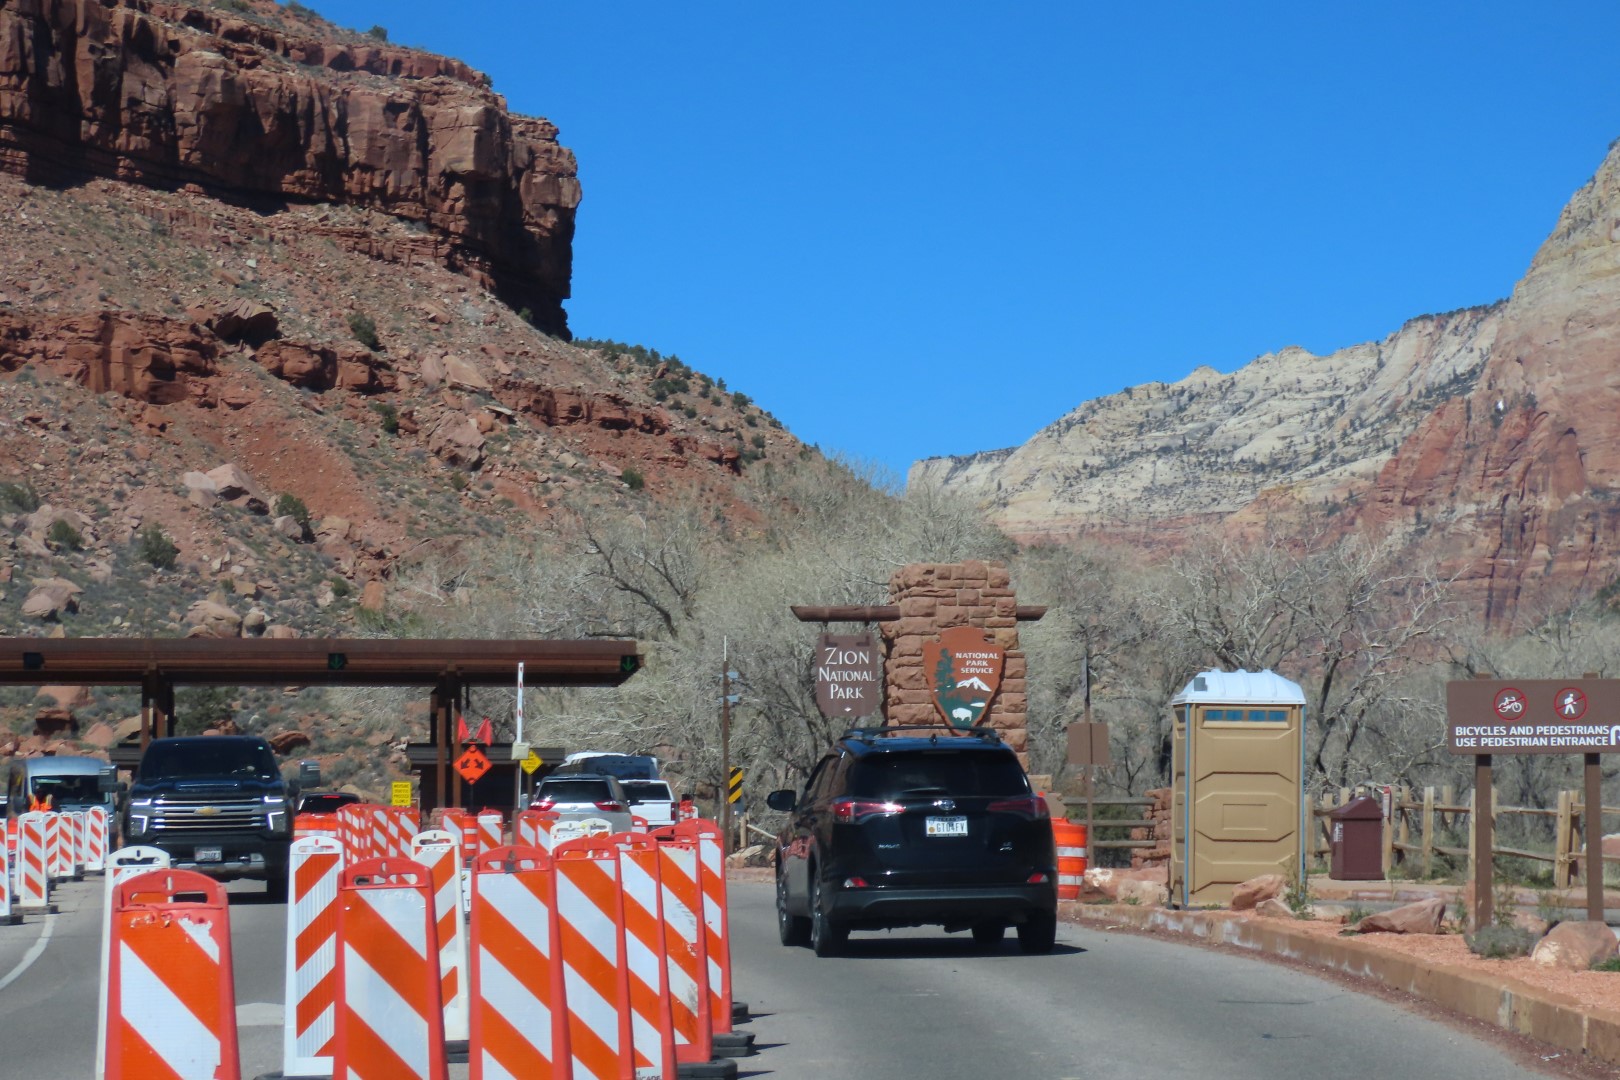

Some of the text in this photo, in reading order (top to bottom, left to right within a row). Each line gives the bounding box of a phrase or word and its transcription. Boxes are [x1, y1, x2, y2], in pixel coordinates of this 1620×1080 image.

[824, 647, 870, 665] ZION
[819, 666, 876, 682] NATIONAL
[830, 683, 865, 699] PARK
[1455, 725, 1610, 736] BICYCLES AND PEDESTRIANS
[1455, 736, 1609, 747] USE PEDESTRIAN ENTRANCE
